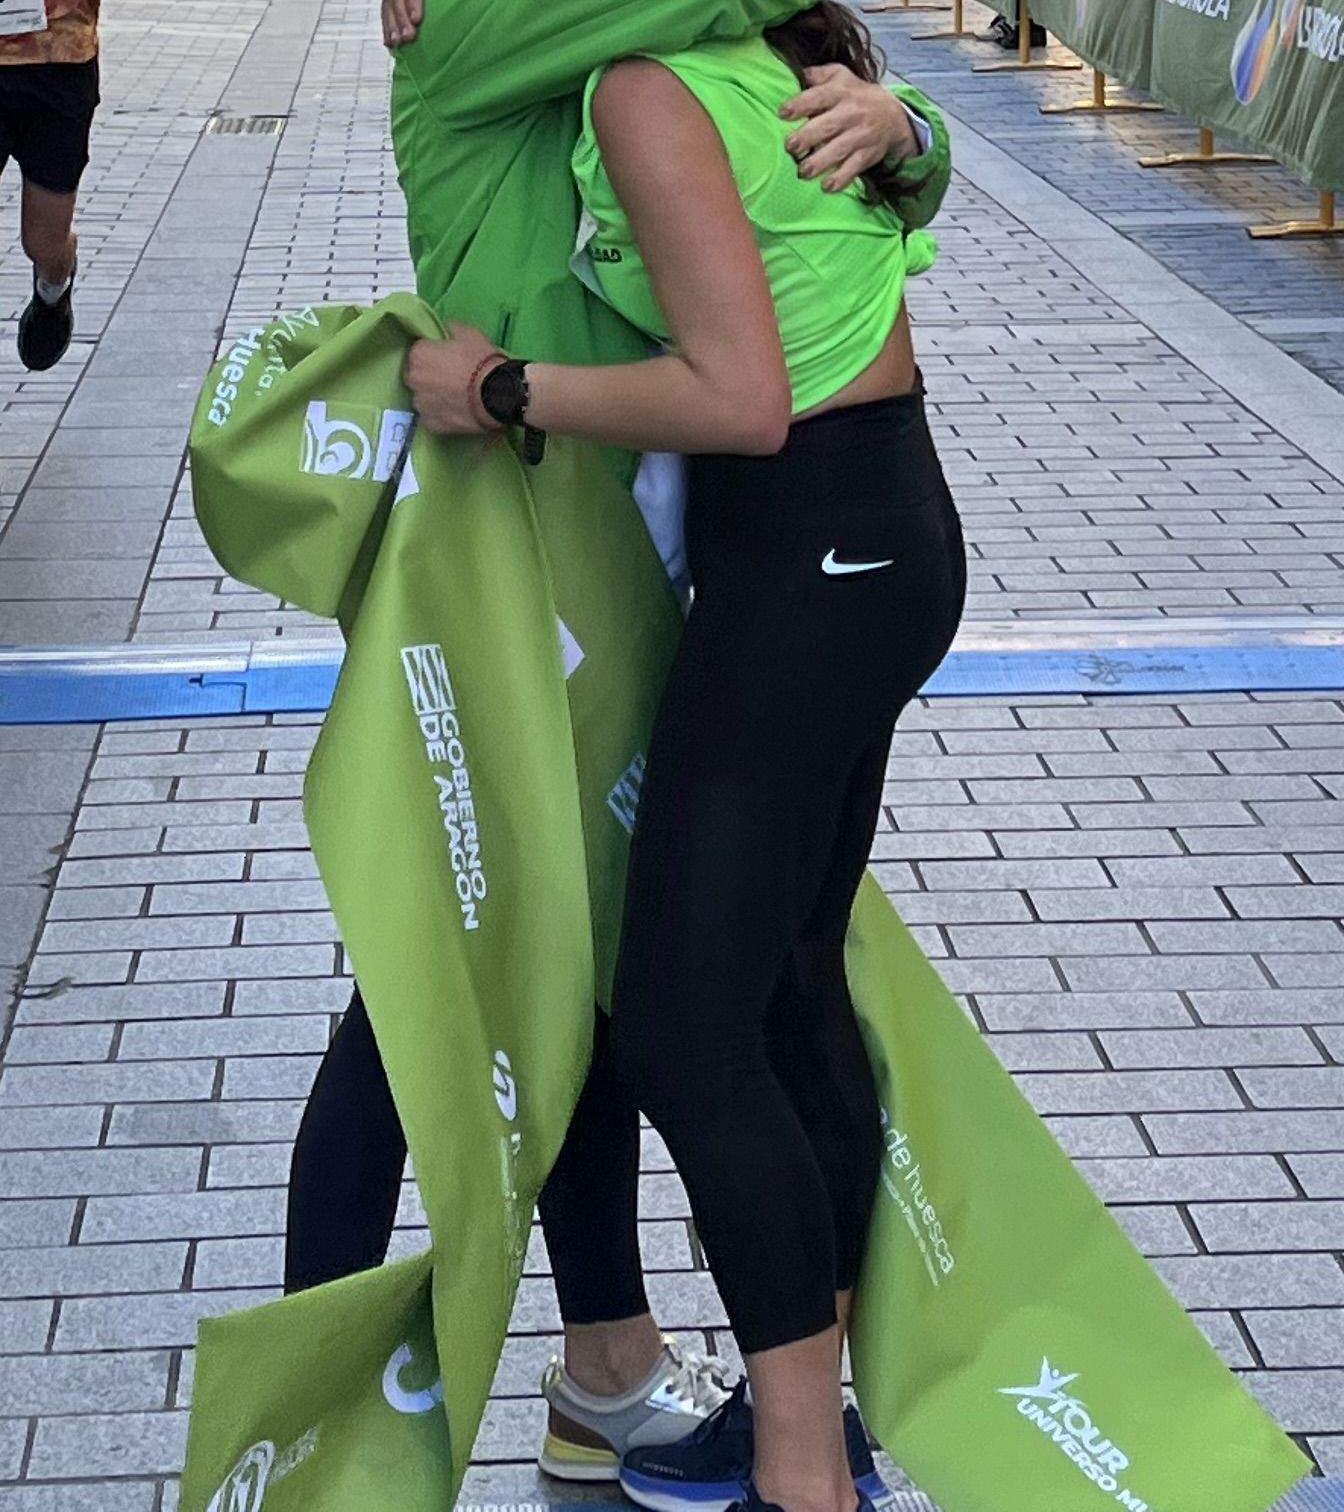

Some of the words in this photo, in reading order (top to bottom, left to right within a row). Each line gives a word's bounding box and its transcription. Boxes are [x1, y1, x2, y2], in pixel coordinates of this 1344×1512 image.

[420, 714, 447, 763] DE
[441, 711, 487, 900] GOBIERNO
[886, 1128, 911, 1170] de
[904, 1162, 955, 1275] huesca
[1016, 1397, 1118, 1492] UNIVERSO
[1047, 1390, 1130, 1475] TOUR
